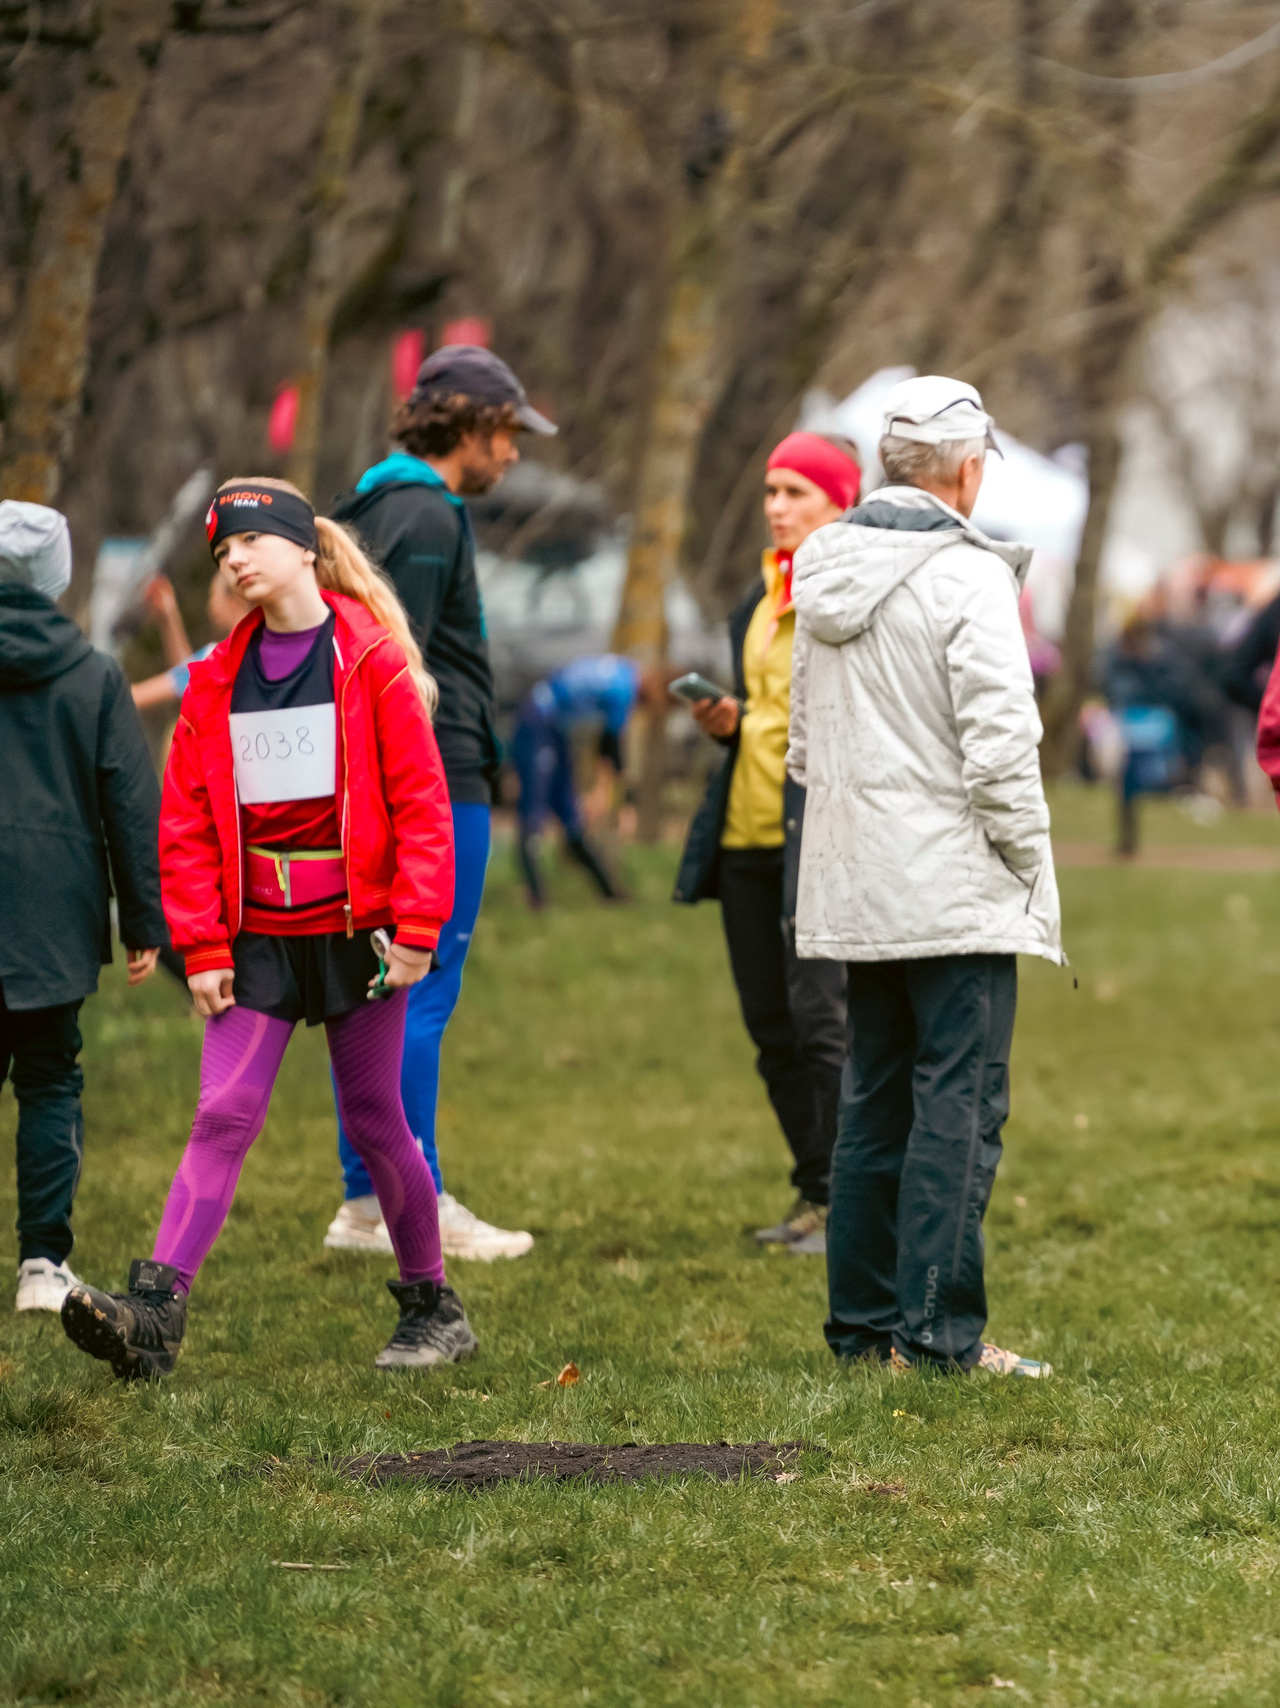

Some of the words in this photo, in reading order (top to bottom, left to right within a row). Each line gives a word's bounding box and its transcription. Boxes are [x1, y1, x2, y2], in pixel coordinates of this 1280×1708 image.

[219, 491, 273, 506] BUTOVO
[233, 499, 259, 508] TEAM
[239, 726, 315, 762] 2038
